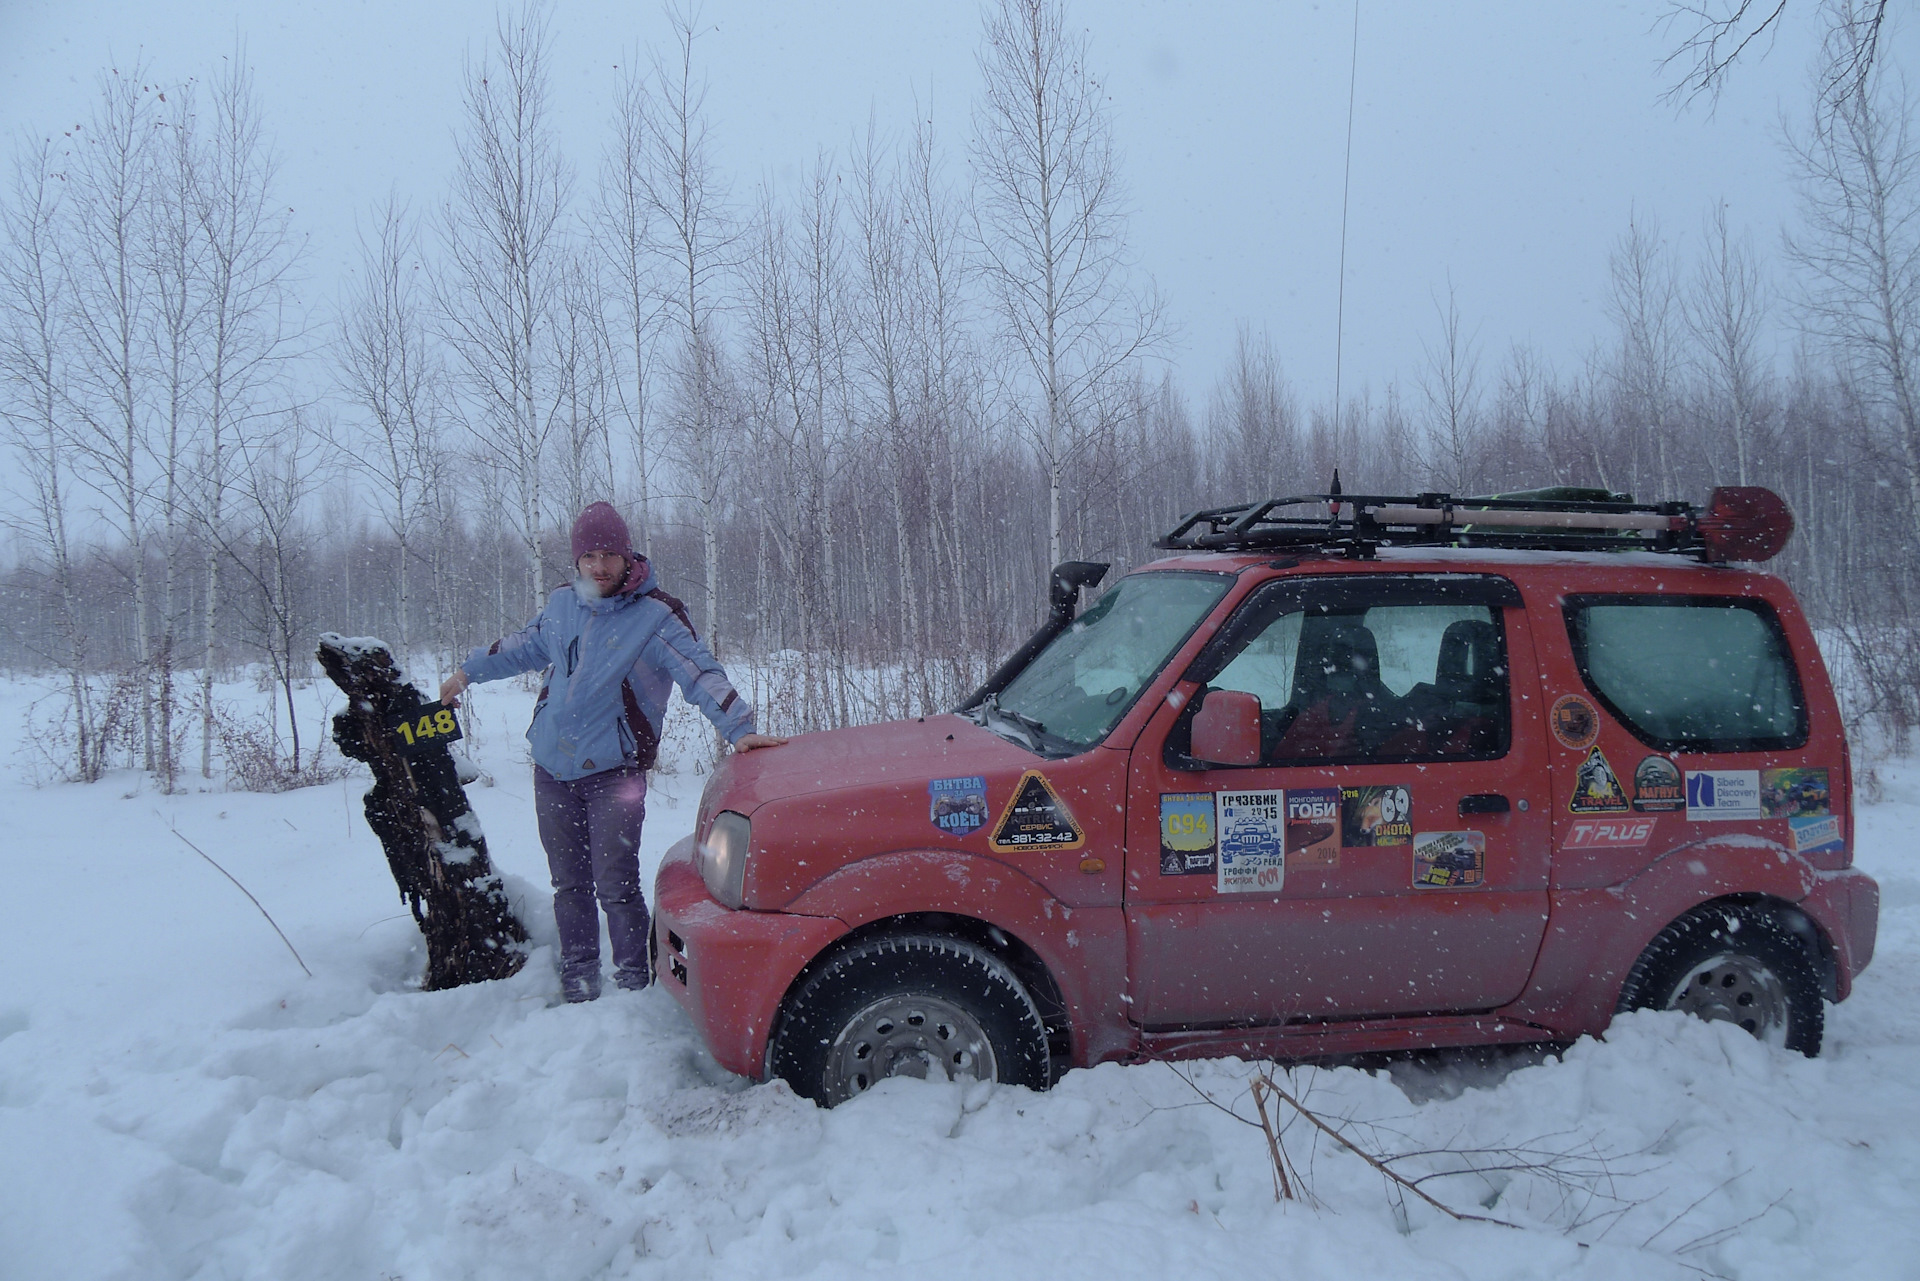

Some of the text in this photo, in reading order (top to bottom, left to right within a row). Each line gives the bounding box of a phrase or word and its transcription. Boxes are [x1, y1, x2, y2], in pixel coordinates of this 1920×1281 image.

[396, 710, 455, 745] 148
[933, 777, 981, 791] БИТВА
[1717, 777, 1745, 787] Siberia
[1342, 790, 1359, 799] 2016
[1639, 786, 1680, 798] МАГНУС
[1717, 788, 1757, 798] Discovery
[1222, 794, 1277, 807] ГРЯЗЕВИК
[1580, 796, 1623, 806] TRAVEL
[1717, 798, 1740, 807] Team
[1289, 802, 1337, 819] ГОБИ
[939, 811, 980, 828] КОЁН
[1011, 814, 1056, 824] PATRIO
[1168, 813, 1208, 835] 094
[1020, 823, 1053, 831] СЕРВИС
[1375, 822, 1411, 836] ОХОТА
[1593, 824, 1651, 841] PLUS
[1011, 832, 1072, 843] 381-32-42
[1317, 847, 1337, 859] 2016
[1263, 857, 1283, 866] РЕЙД
[1223, 867, 1257, 876] ТРОФФИ
